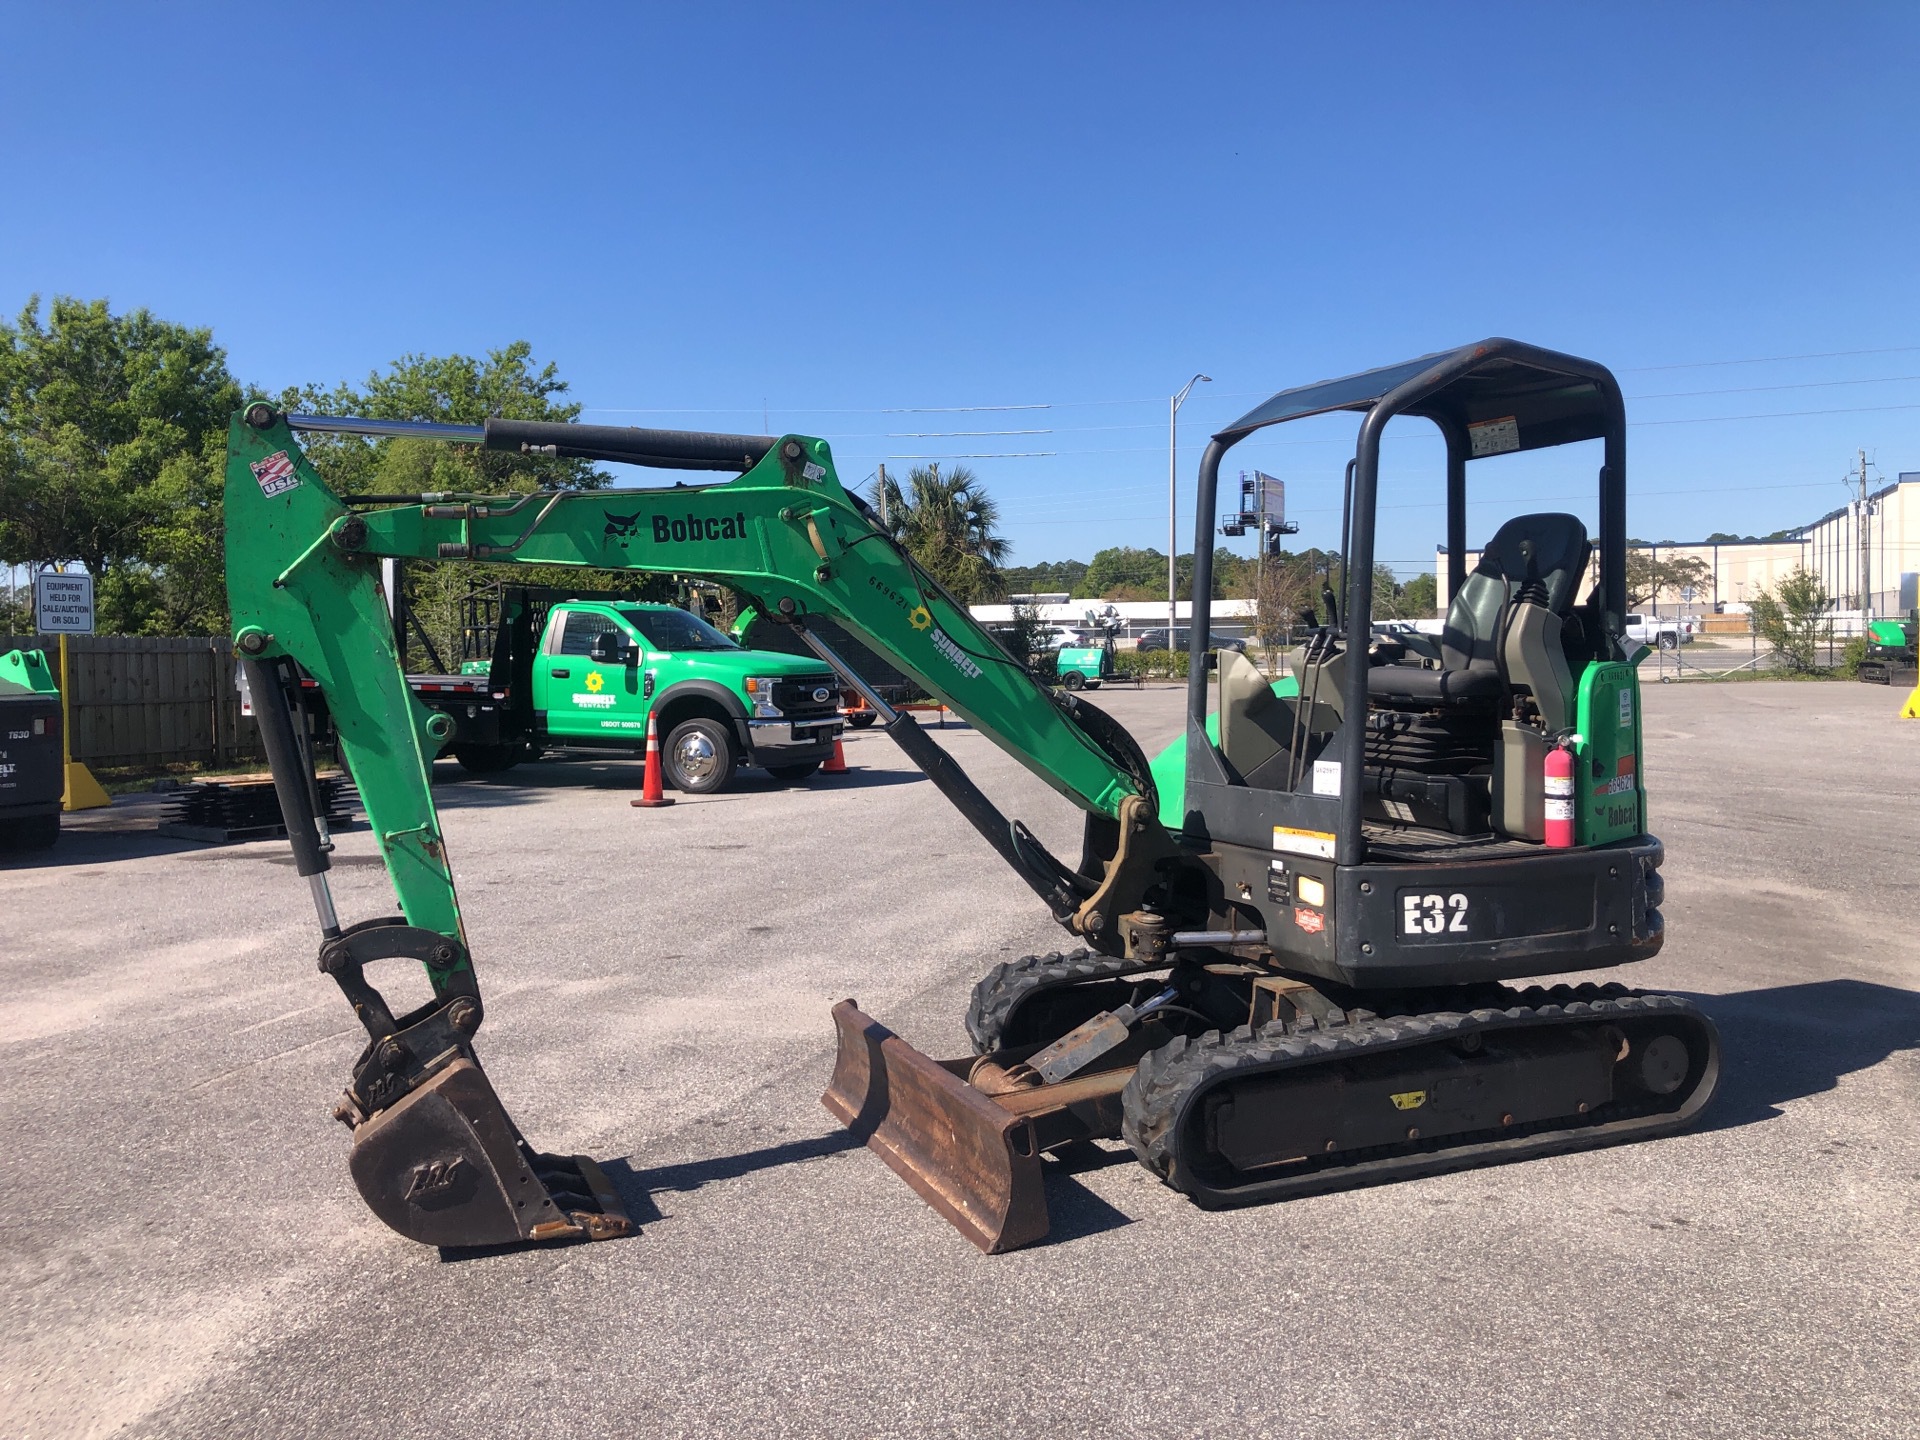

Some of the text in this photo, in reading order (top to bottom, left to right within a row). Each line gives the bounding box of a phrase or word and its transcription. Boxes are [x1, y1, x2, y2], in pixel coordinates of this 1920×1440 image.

[264, 476, 298, 493] USA
[652, 512, 747, 543] Bobcat
[46, 582, 83, 591] EQUIPMENT
[868, 576, 908, 609] 669621
[49, 593, 81, 602] HELD FOR
[42, 604, 89, 613] SALE/AUCTION
[52, 615, 80, 624] OR SOLD
[930, 628, 983, 679] SUNBELT
[933, 643, 969, 678] RENTALS
[8, 730, 30, 739] T630
[1608, 803, 1636, 827] Bobcat
[1404, 893, 1469, 934] E32
